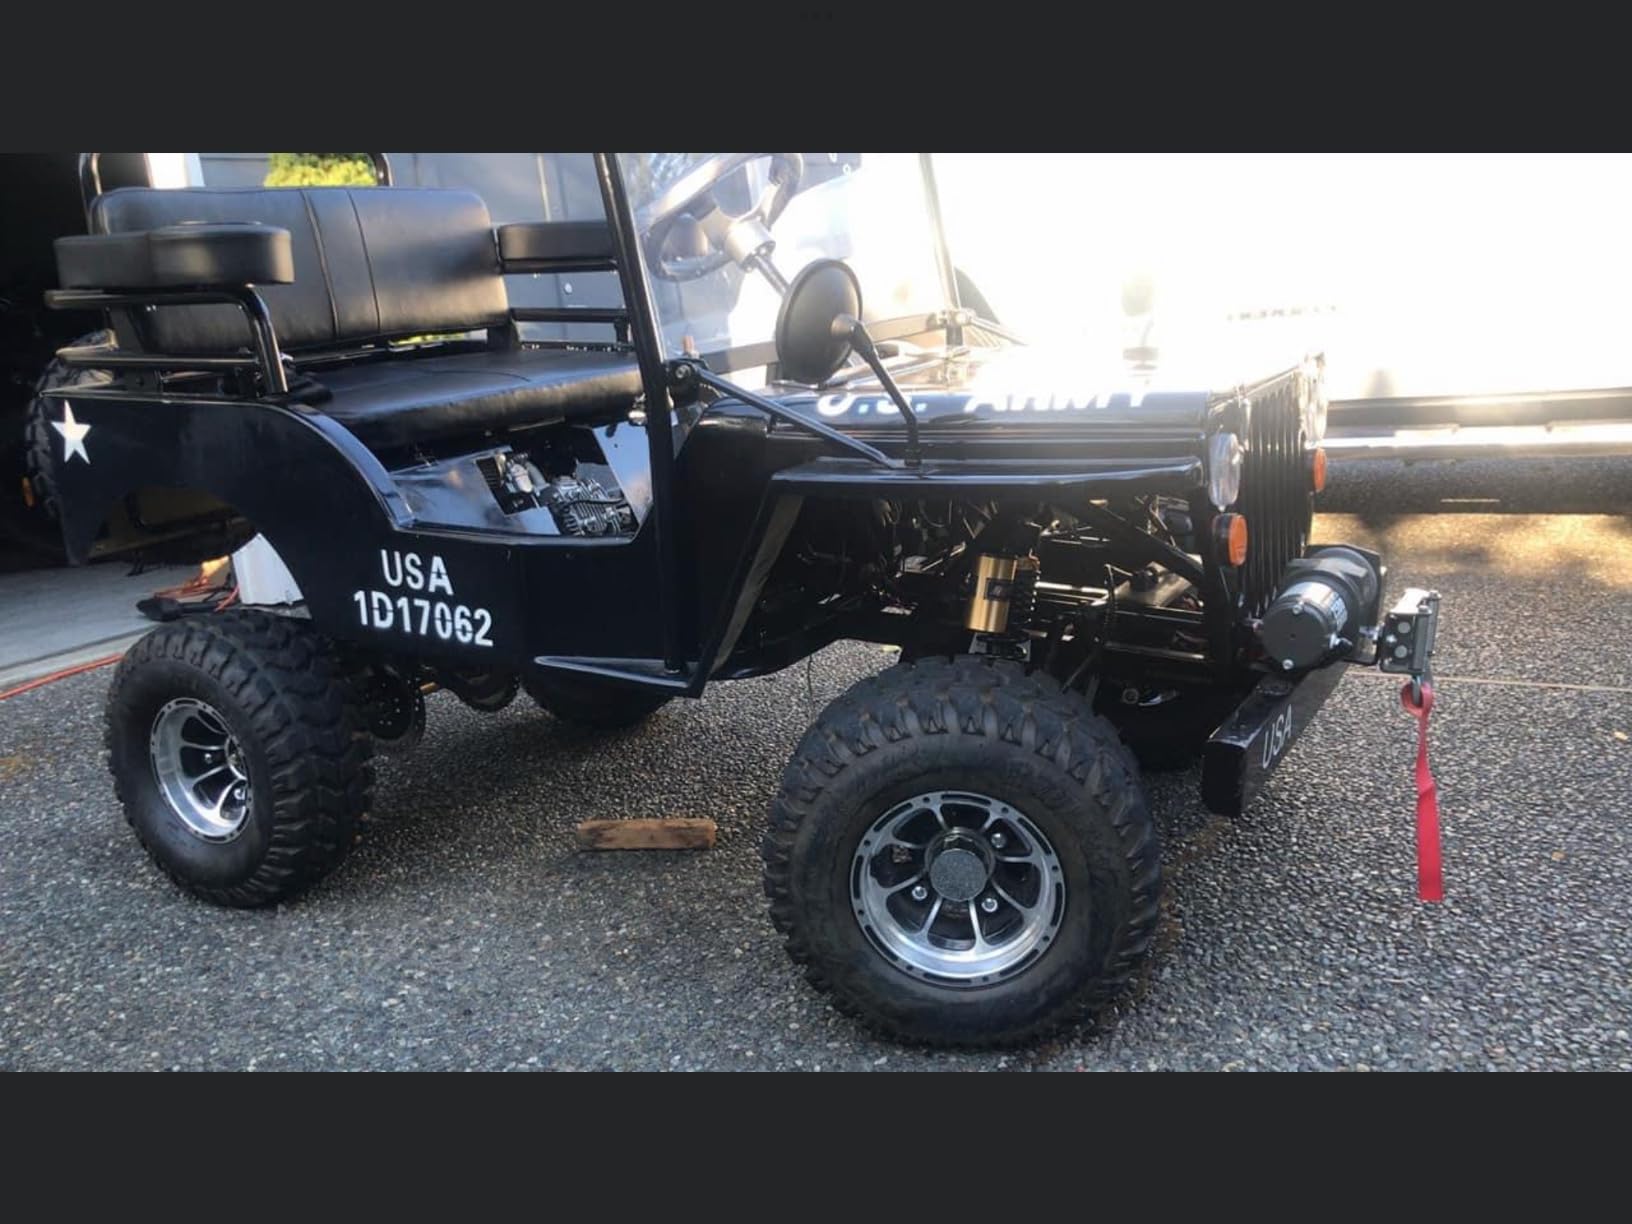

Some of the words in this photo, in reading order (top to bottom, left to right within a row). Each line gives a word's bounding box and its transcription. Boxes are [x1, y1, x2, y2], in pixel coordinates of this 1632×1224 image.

[380, 549, 454, 596] USA
[353, 590, 494, 647] 1D17062
[1262, 703, 1292, 769] USA
